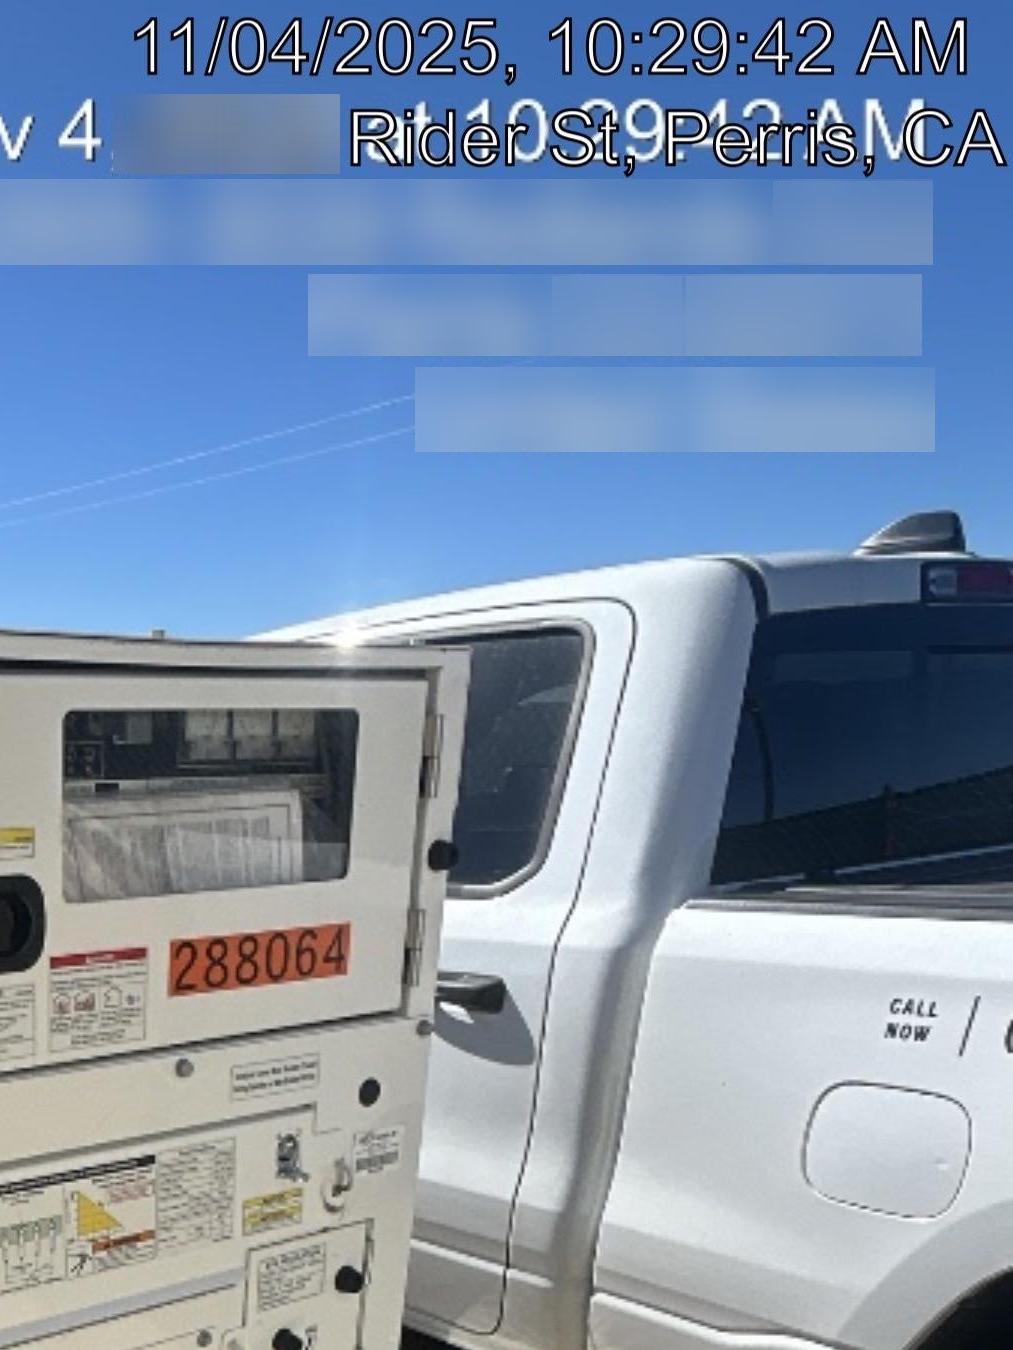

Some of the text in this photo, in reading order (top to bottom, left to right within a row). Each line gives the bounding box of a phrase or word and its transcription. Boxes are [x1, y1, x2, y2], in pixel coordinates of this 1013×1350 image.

[174, 928, 346, 991] 288064
[889, 998, 939, 1018] CALL
[884, 1022, 931, 1042] NOW
